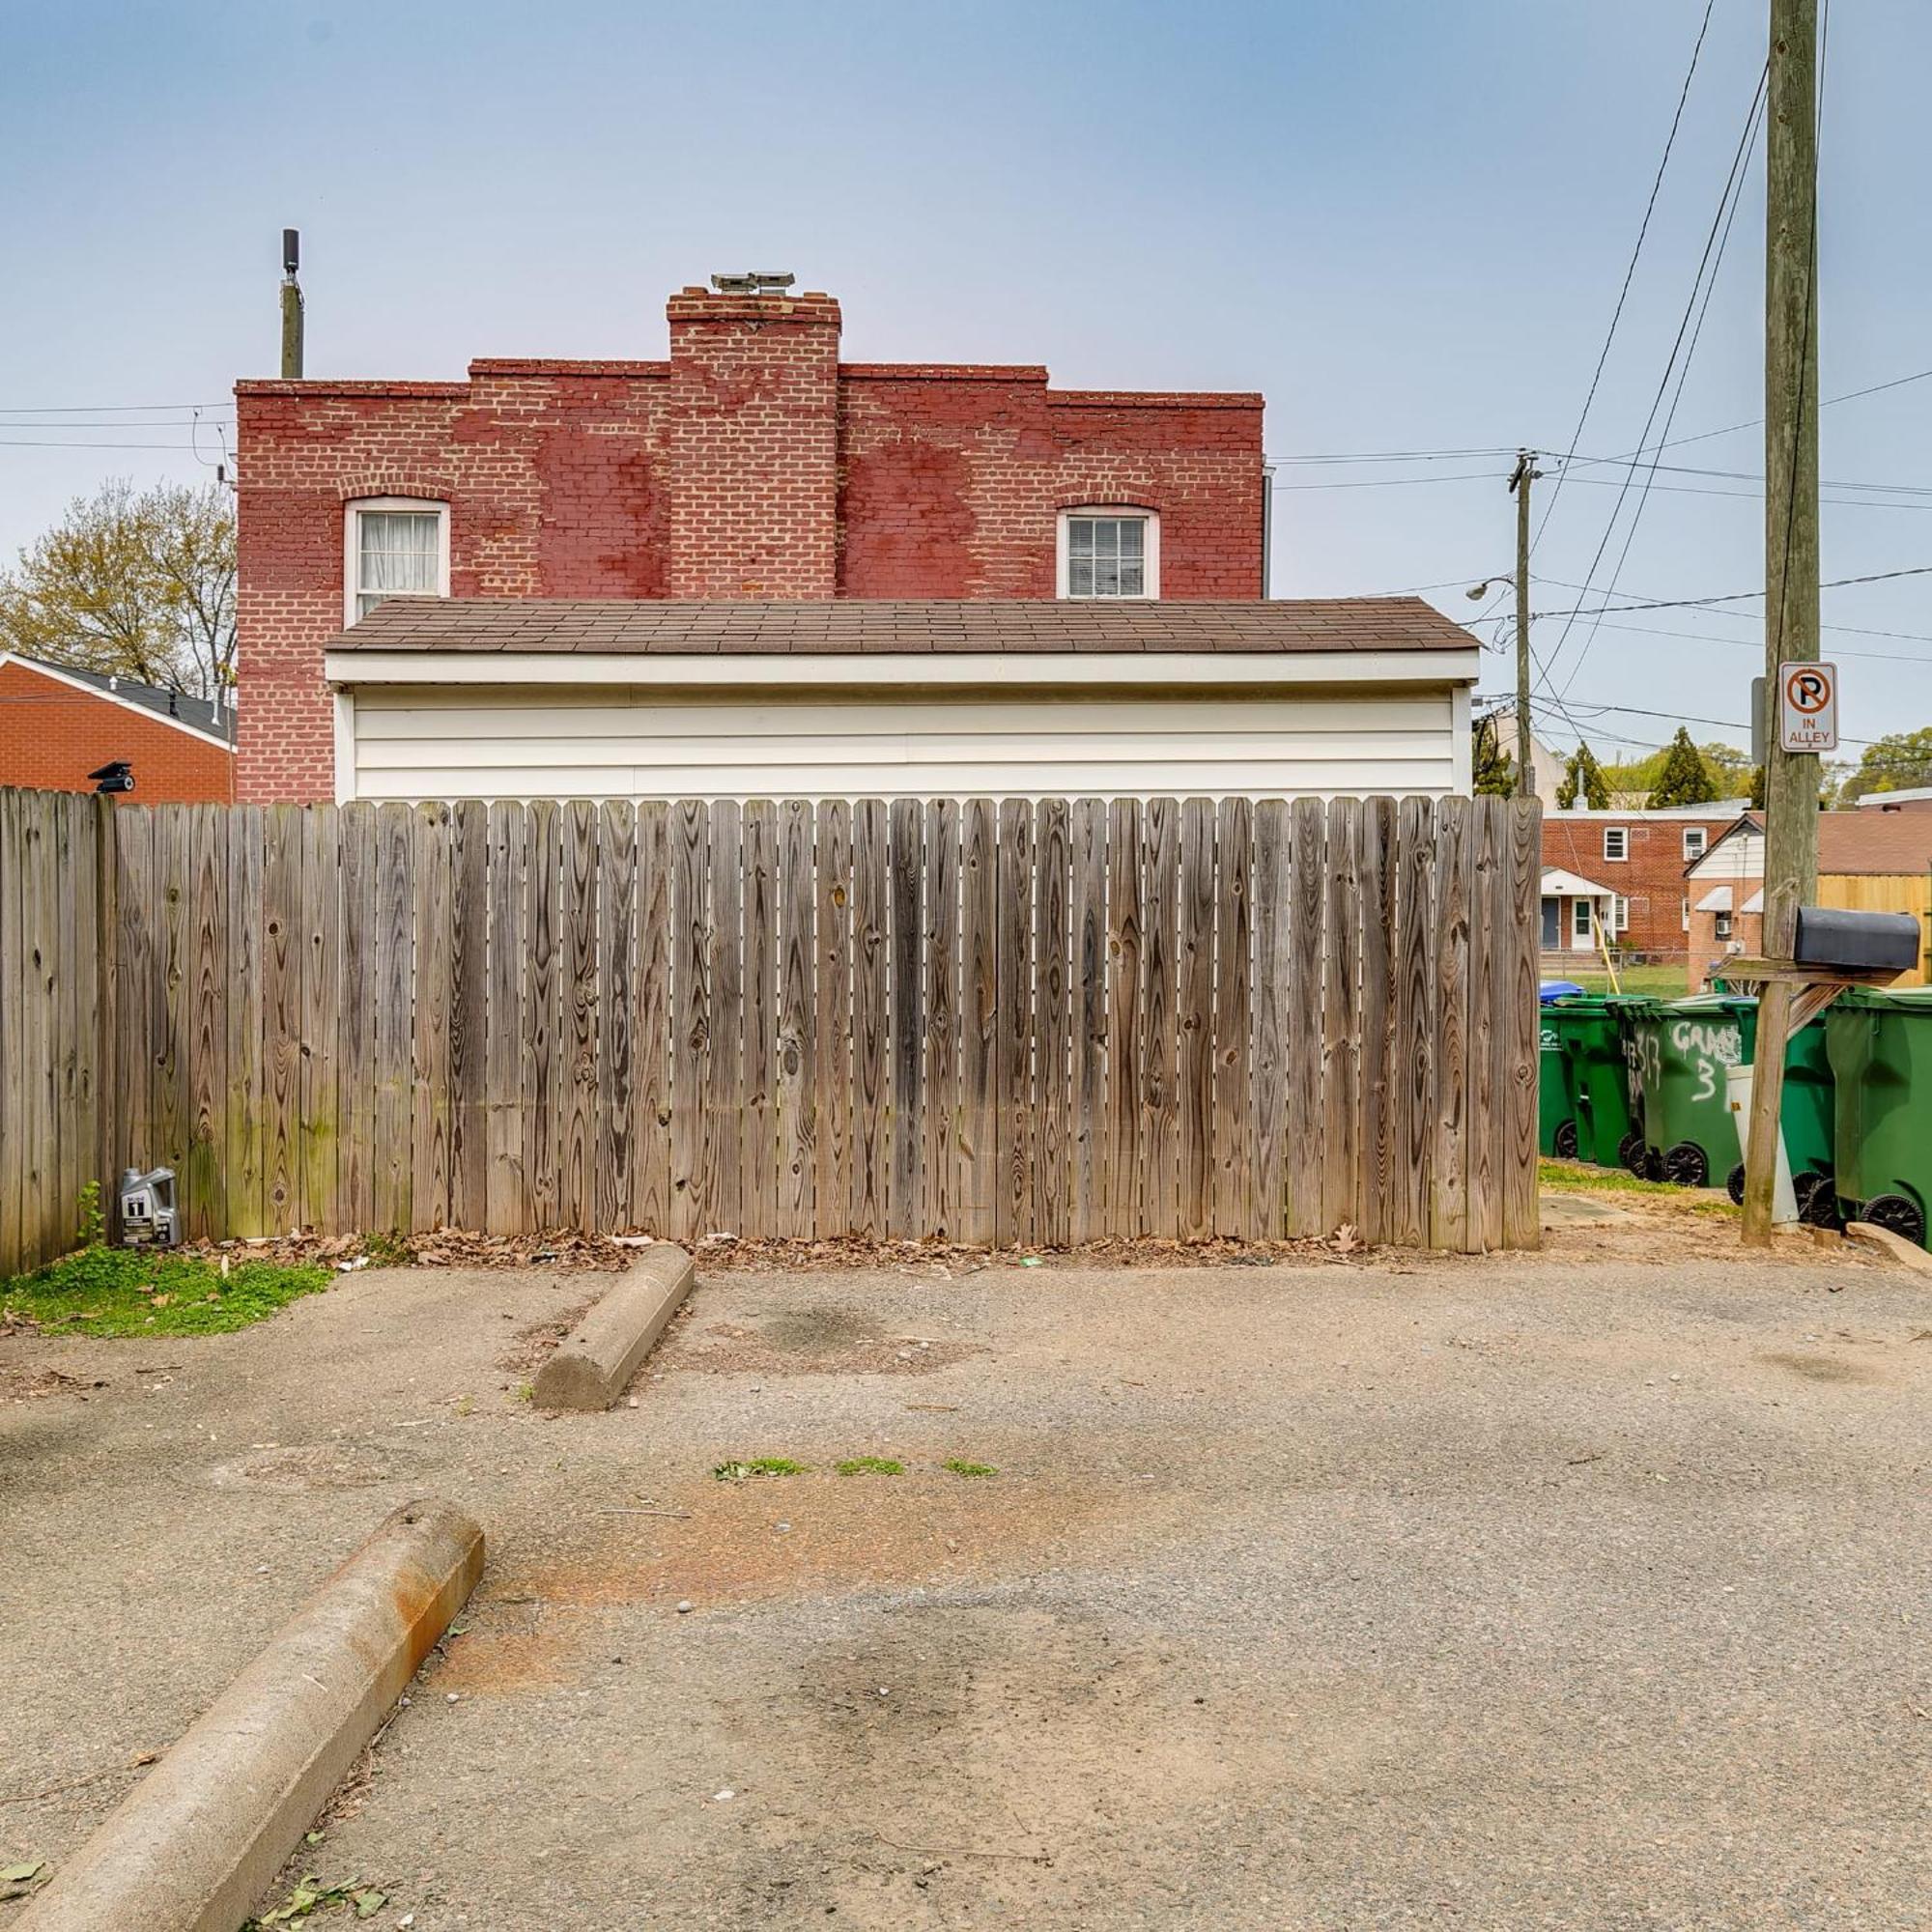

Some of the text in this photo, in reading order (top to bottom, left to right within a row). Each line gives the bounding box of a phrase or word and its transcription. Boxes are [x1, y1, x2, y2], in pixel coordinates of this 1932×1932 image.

[1801, 677, 1821, 705] P
[1803, 718, 1815, 729] IN
[1789, 732, 1830, 743] ALLEY
[1691, 1058, 1716, 1101] 3
